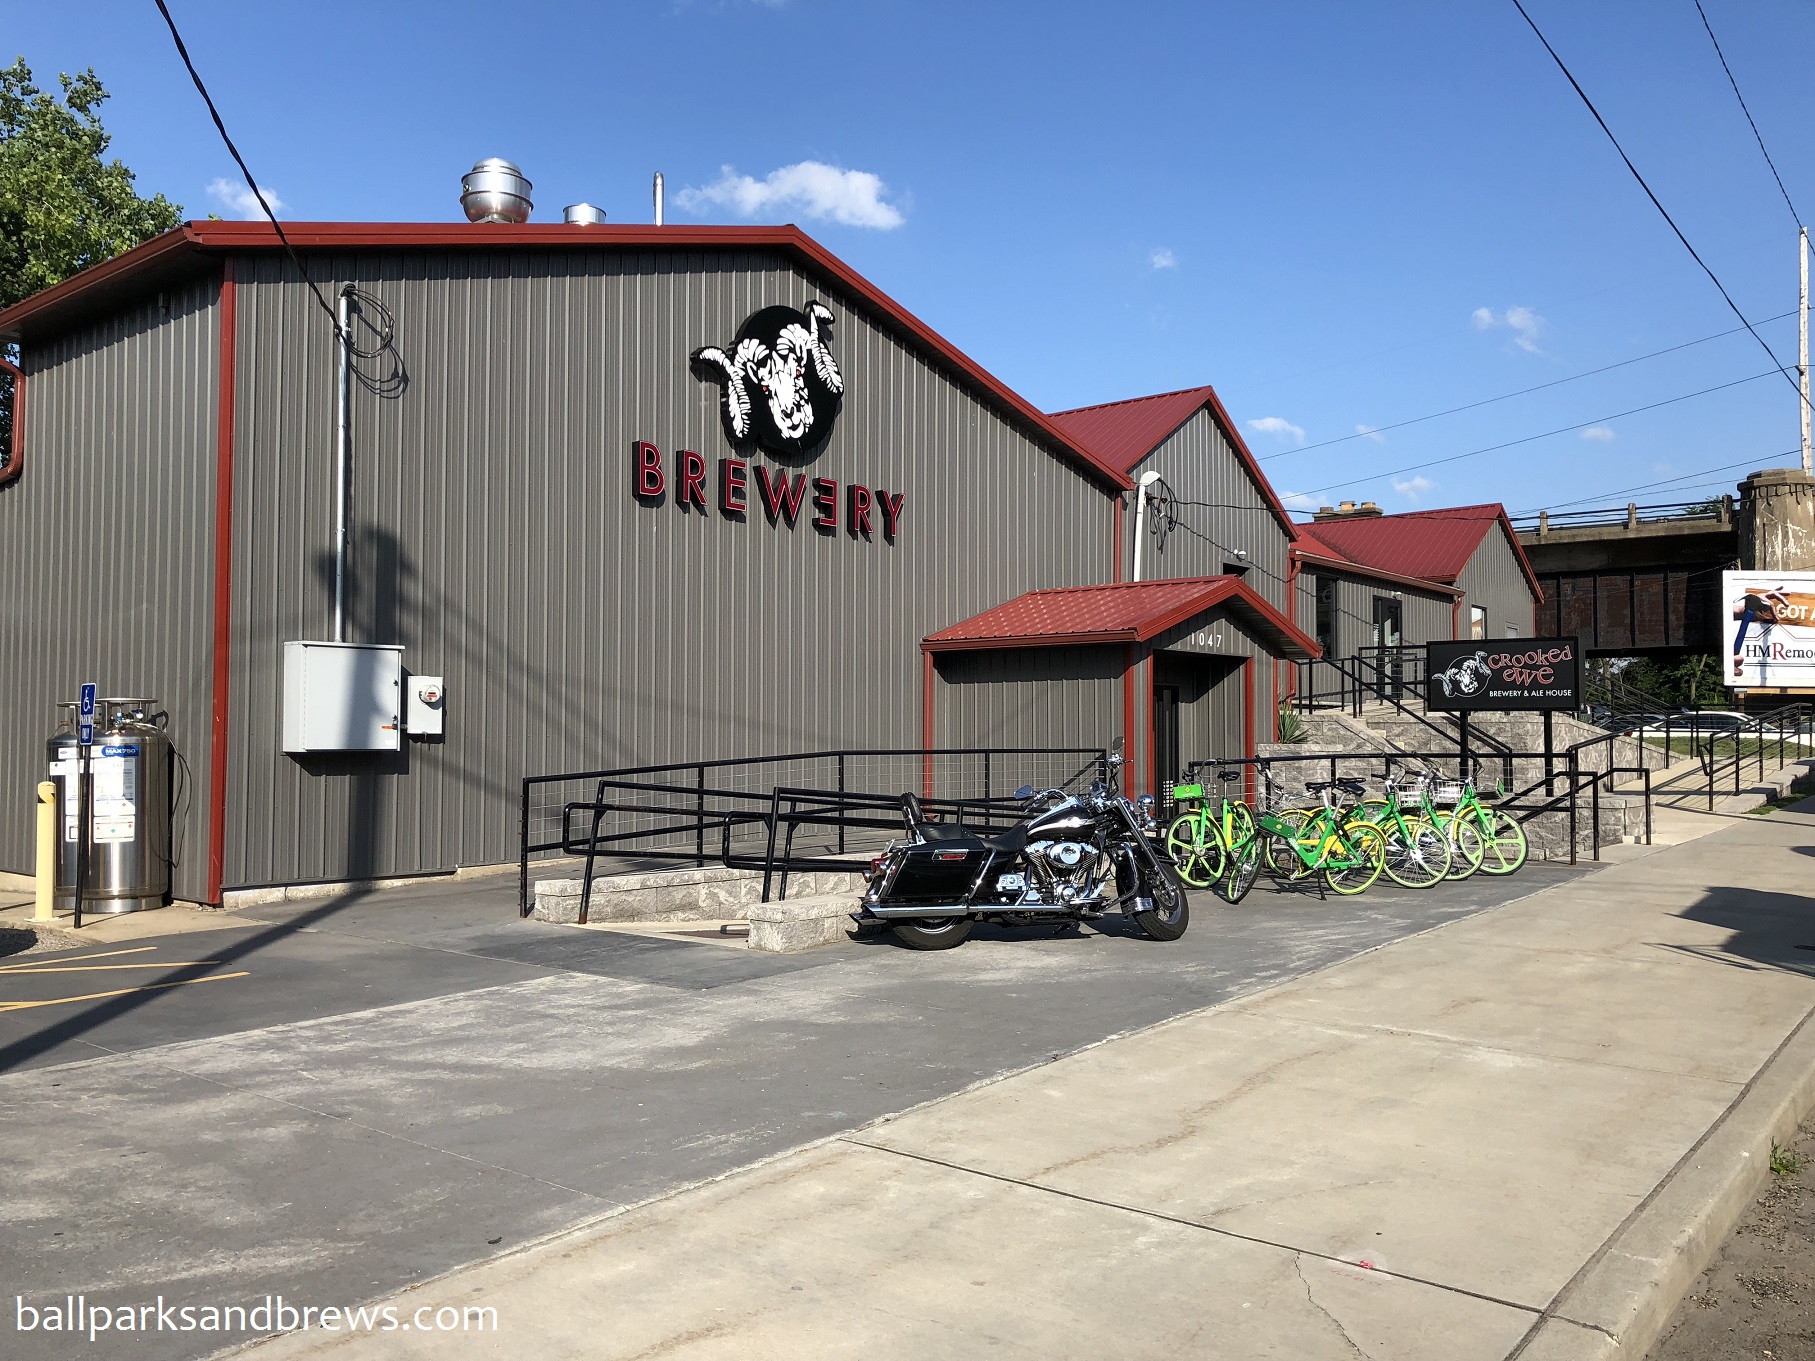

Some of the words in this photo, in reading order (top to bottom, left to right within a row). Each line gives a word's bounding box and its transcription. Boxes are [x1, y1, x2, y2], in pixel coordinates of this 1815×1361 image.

[632, 440, 906, 537] BREWERY
[1776, 604, 1808, 620] GOT
[1191, 632, 1222, 648] 1047
[1745, 642, 1815, 660] HMRemo
[1546, 689, 1572, 697] HOUSE
